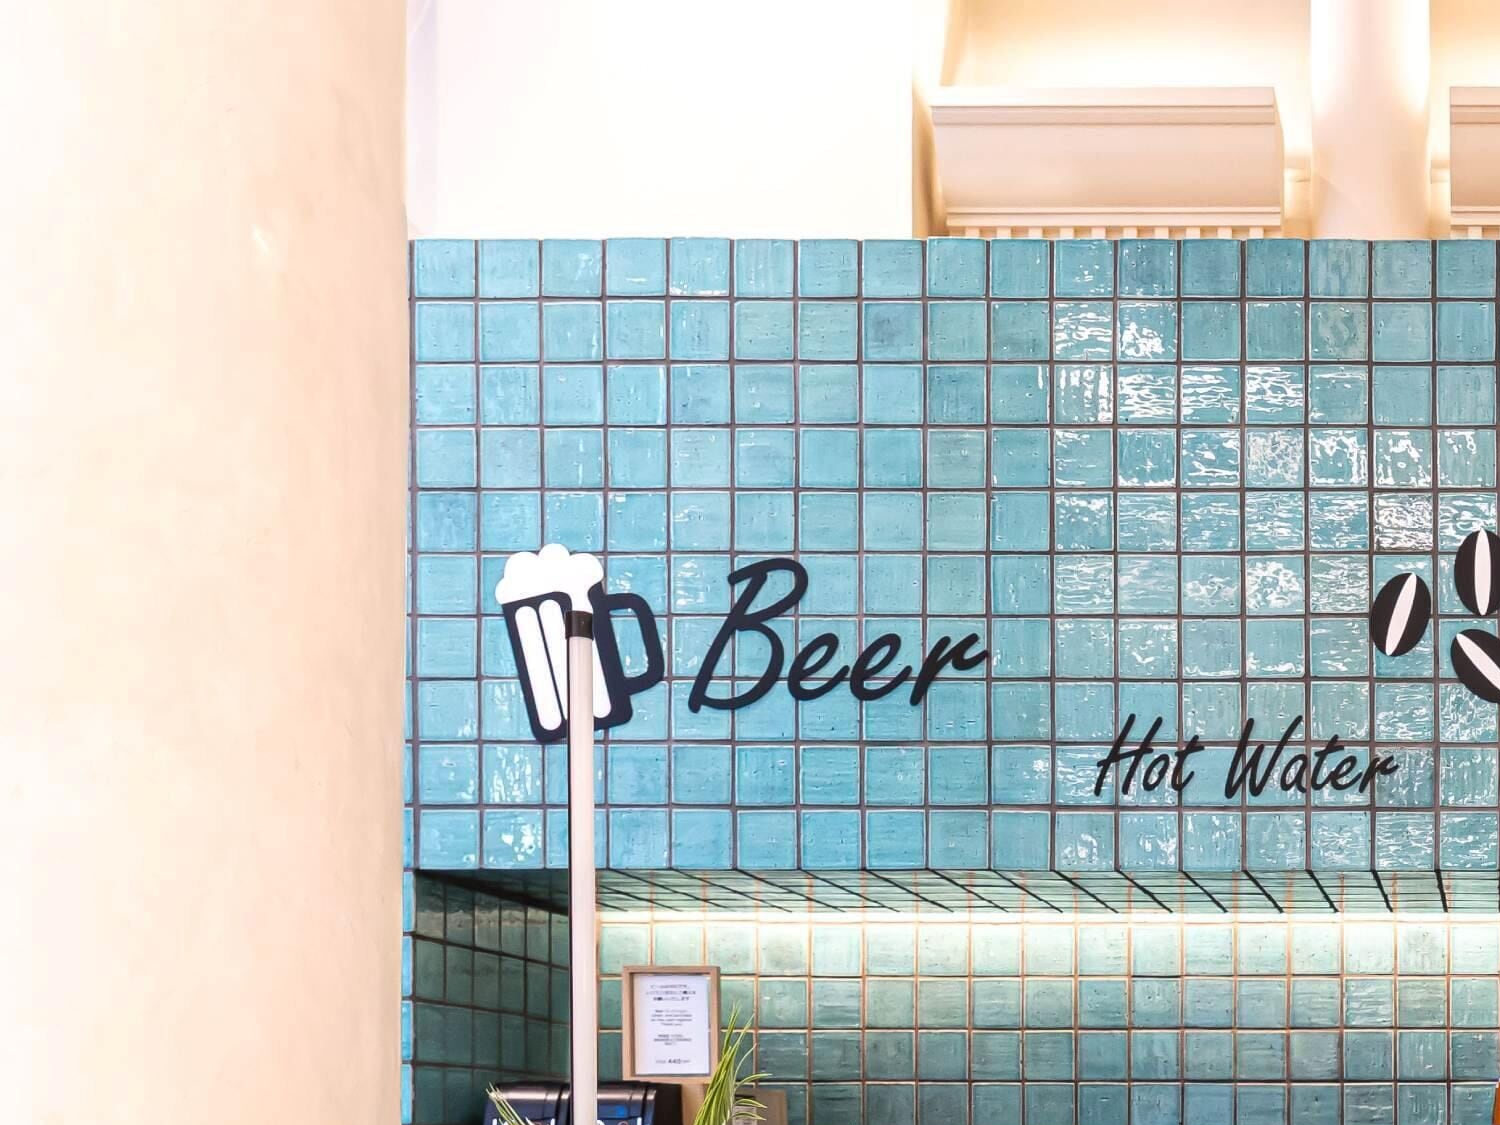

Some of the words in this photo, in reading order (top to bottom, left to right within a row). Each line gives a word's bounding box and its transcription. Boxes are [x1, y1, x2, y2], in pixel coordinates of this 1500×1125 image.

[688, 557, 989, 713] Beer
[1095, 713, 1205, 797] Hot
[1224, 715, 1399, 800] Water
